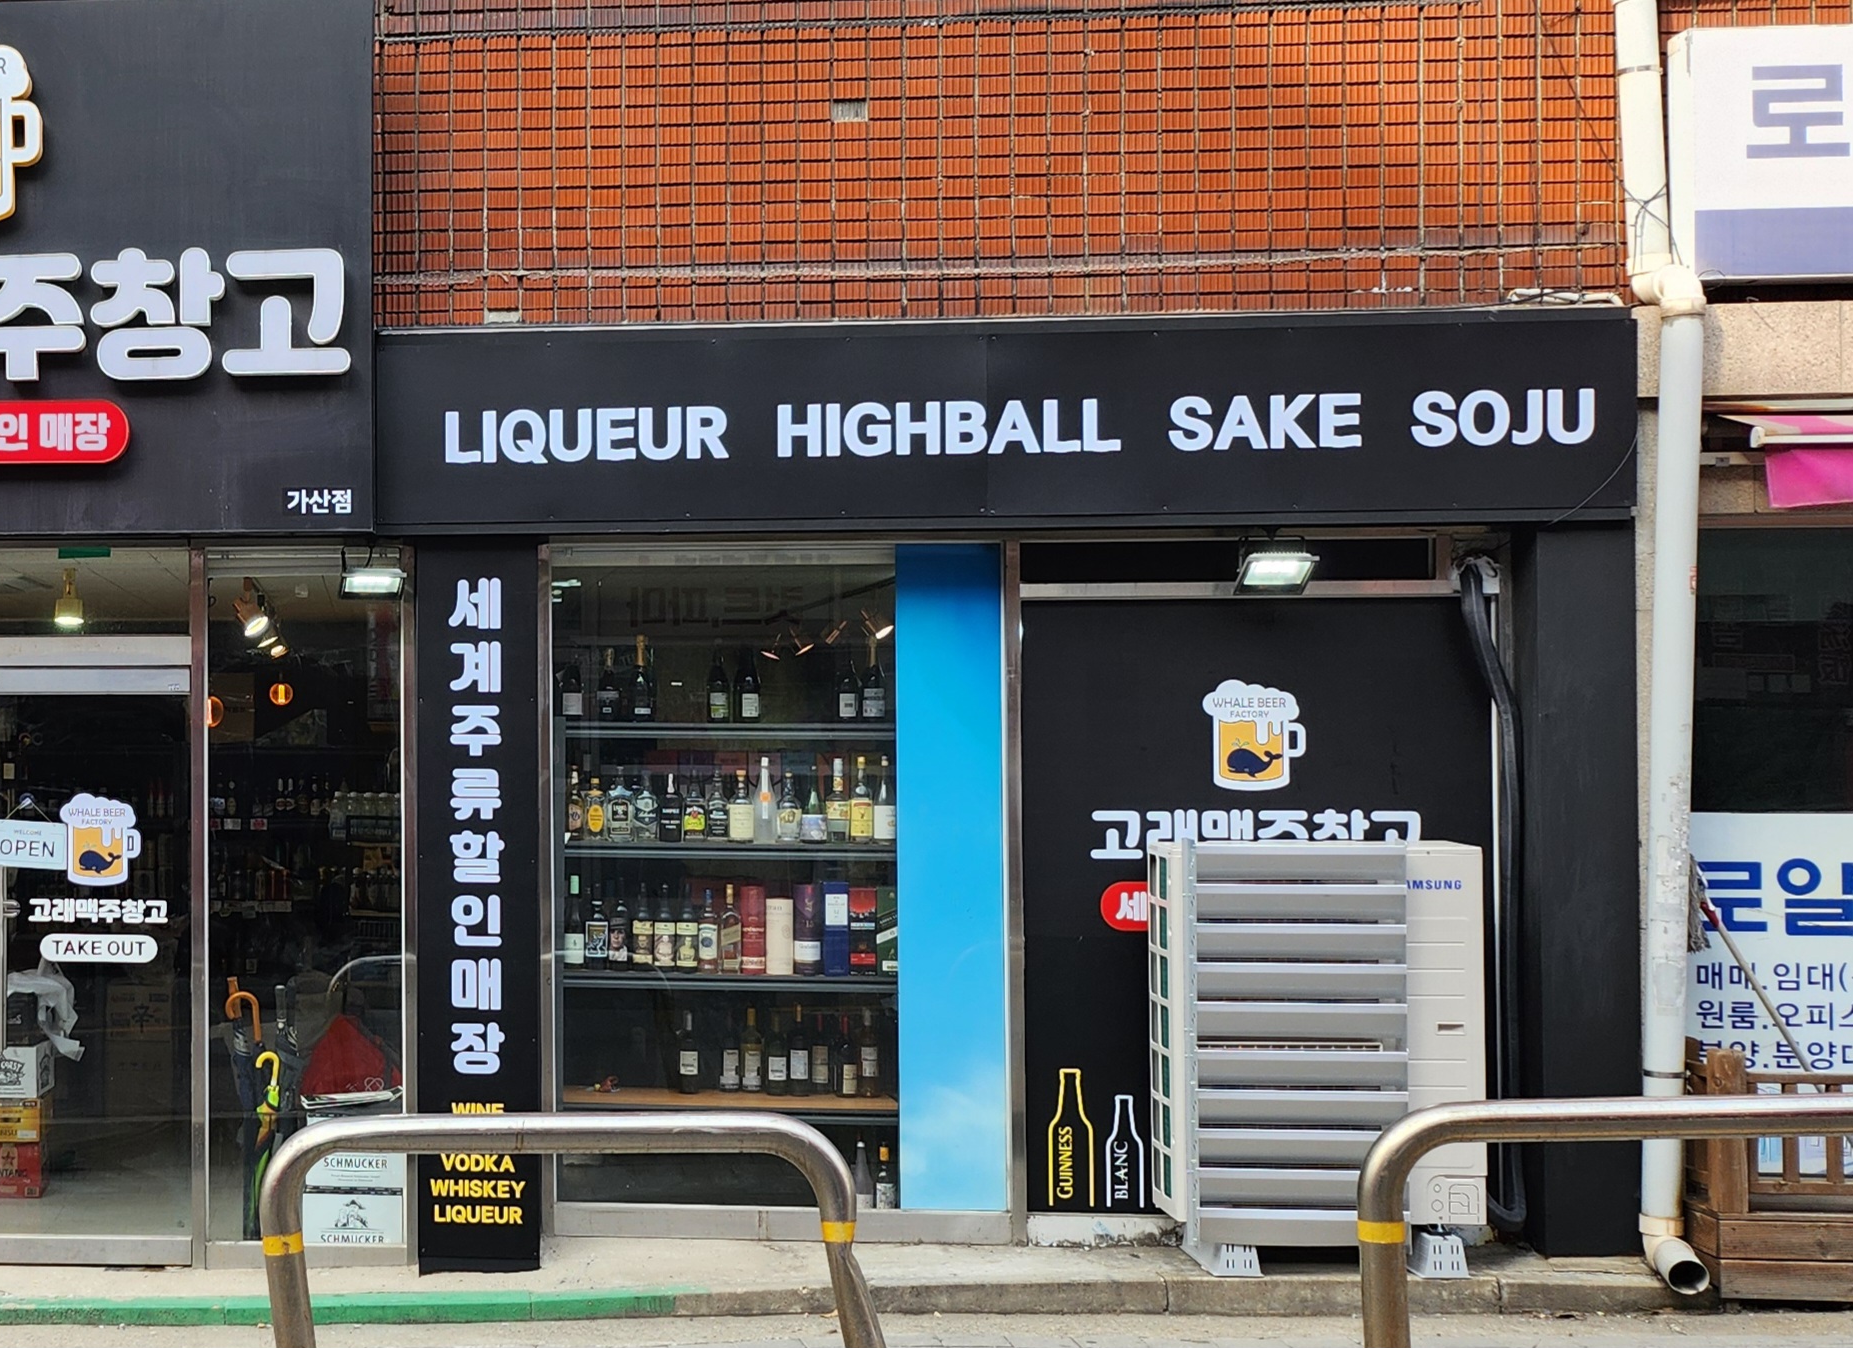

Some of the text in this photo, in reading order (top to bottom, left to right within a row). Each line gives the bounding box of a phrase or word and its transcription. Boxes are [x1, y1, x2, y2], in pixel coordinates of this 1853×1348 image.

[1747, 63, 1851, 159] 로
[39, 411, 112, 452] 매장
[445, 387, 1596, 464] LIQUEUR HIGHBALL SAKE SOJU
[286, 488, 353, 515] 가산점
[1212, 697, 1287, 709] WHALE BEER
[1229, 710, 1270, 719] FACTORY
[68, 807, 126, 818] WHALE BEER
[13, 828, 42, 836] WELCOME
[0, 838, 55, 859] OPEN
[27, 898, 169, 924] 고래맥주창고
[51, 939, 147, 956] TAKE OUT
[323, 1157, 388, 1169] SCHMUCKER
[440, 1153, 516, 1173] VODKA
[1056, 1126, 1074, 1199] GUINNESS
[1113, 1140, 1129, 1200] BLANC
[430, 1178, 526, 1199] WHISKEY
[434, 1204, 523, 1225] LIQUEUR
